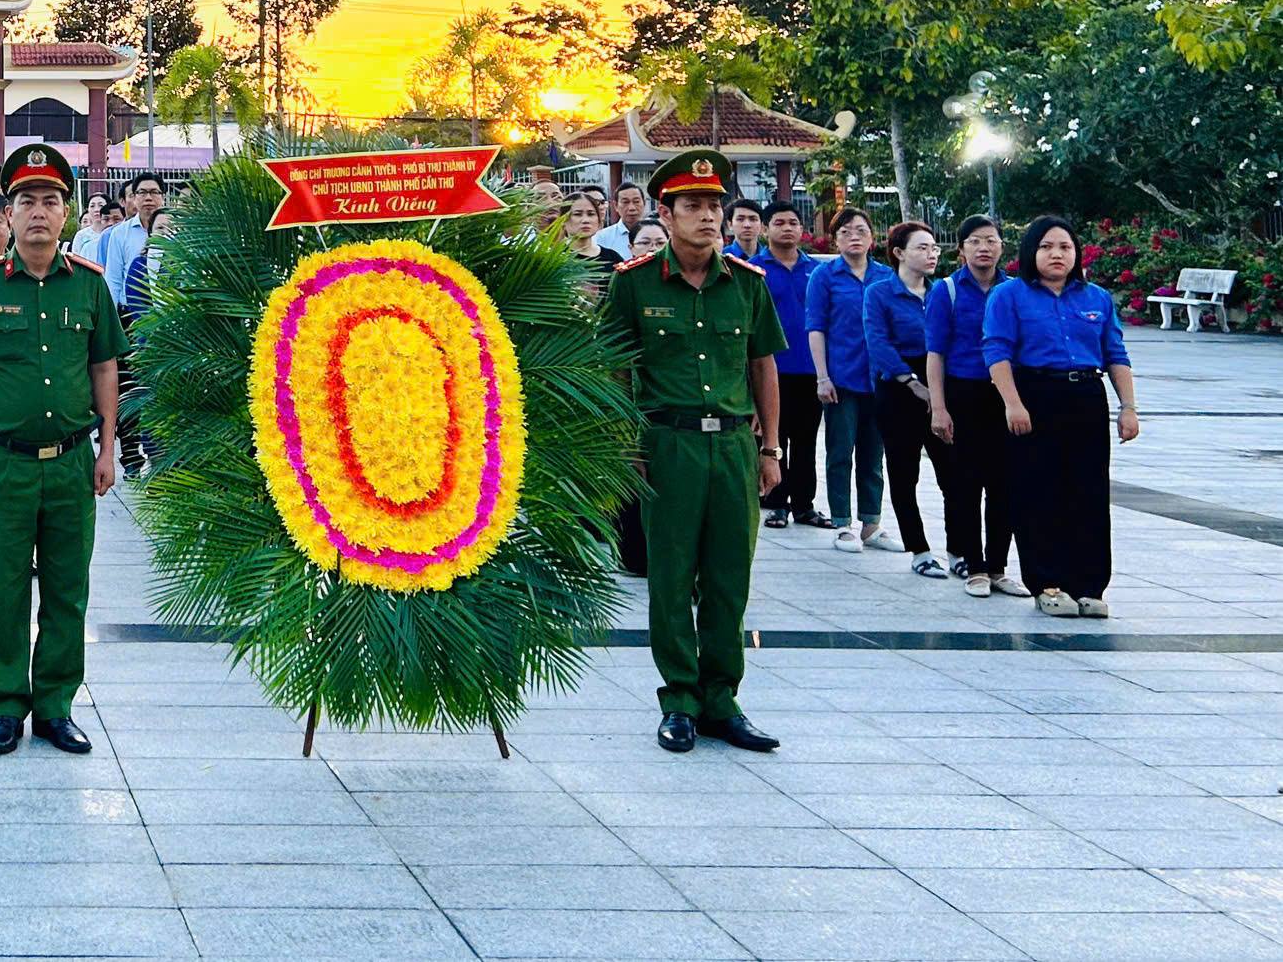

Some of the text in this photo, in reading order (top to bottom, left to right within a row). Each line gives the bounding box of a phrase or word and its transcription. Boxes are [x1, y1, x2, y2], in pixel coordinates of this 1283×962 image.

[312, 180, 329, 196] CHỦ
[330, 182, 349, 196] TỊCH
[350, 181, 374, 194] UBND
[374, 178, 402, 192] THÀNH
[403, 175, 421, 191] PHỐ
[438, 176, 455, 189] THƠ
[386, 195, 437, 212] Viếng
